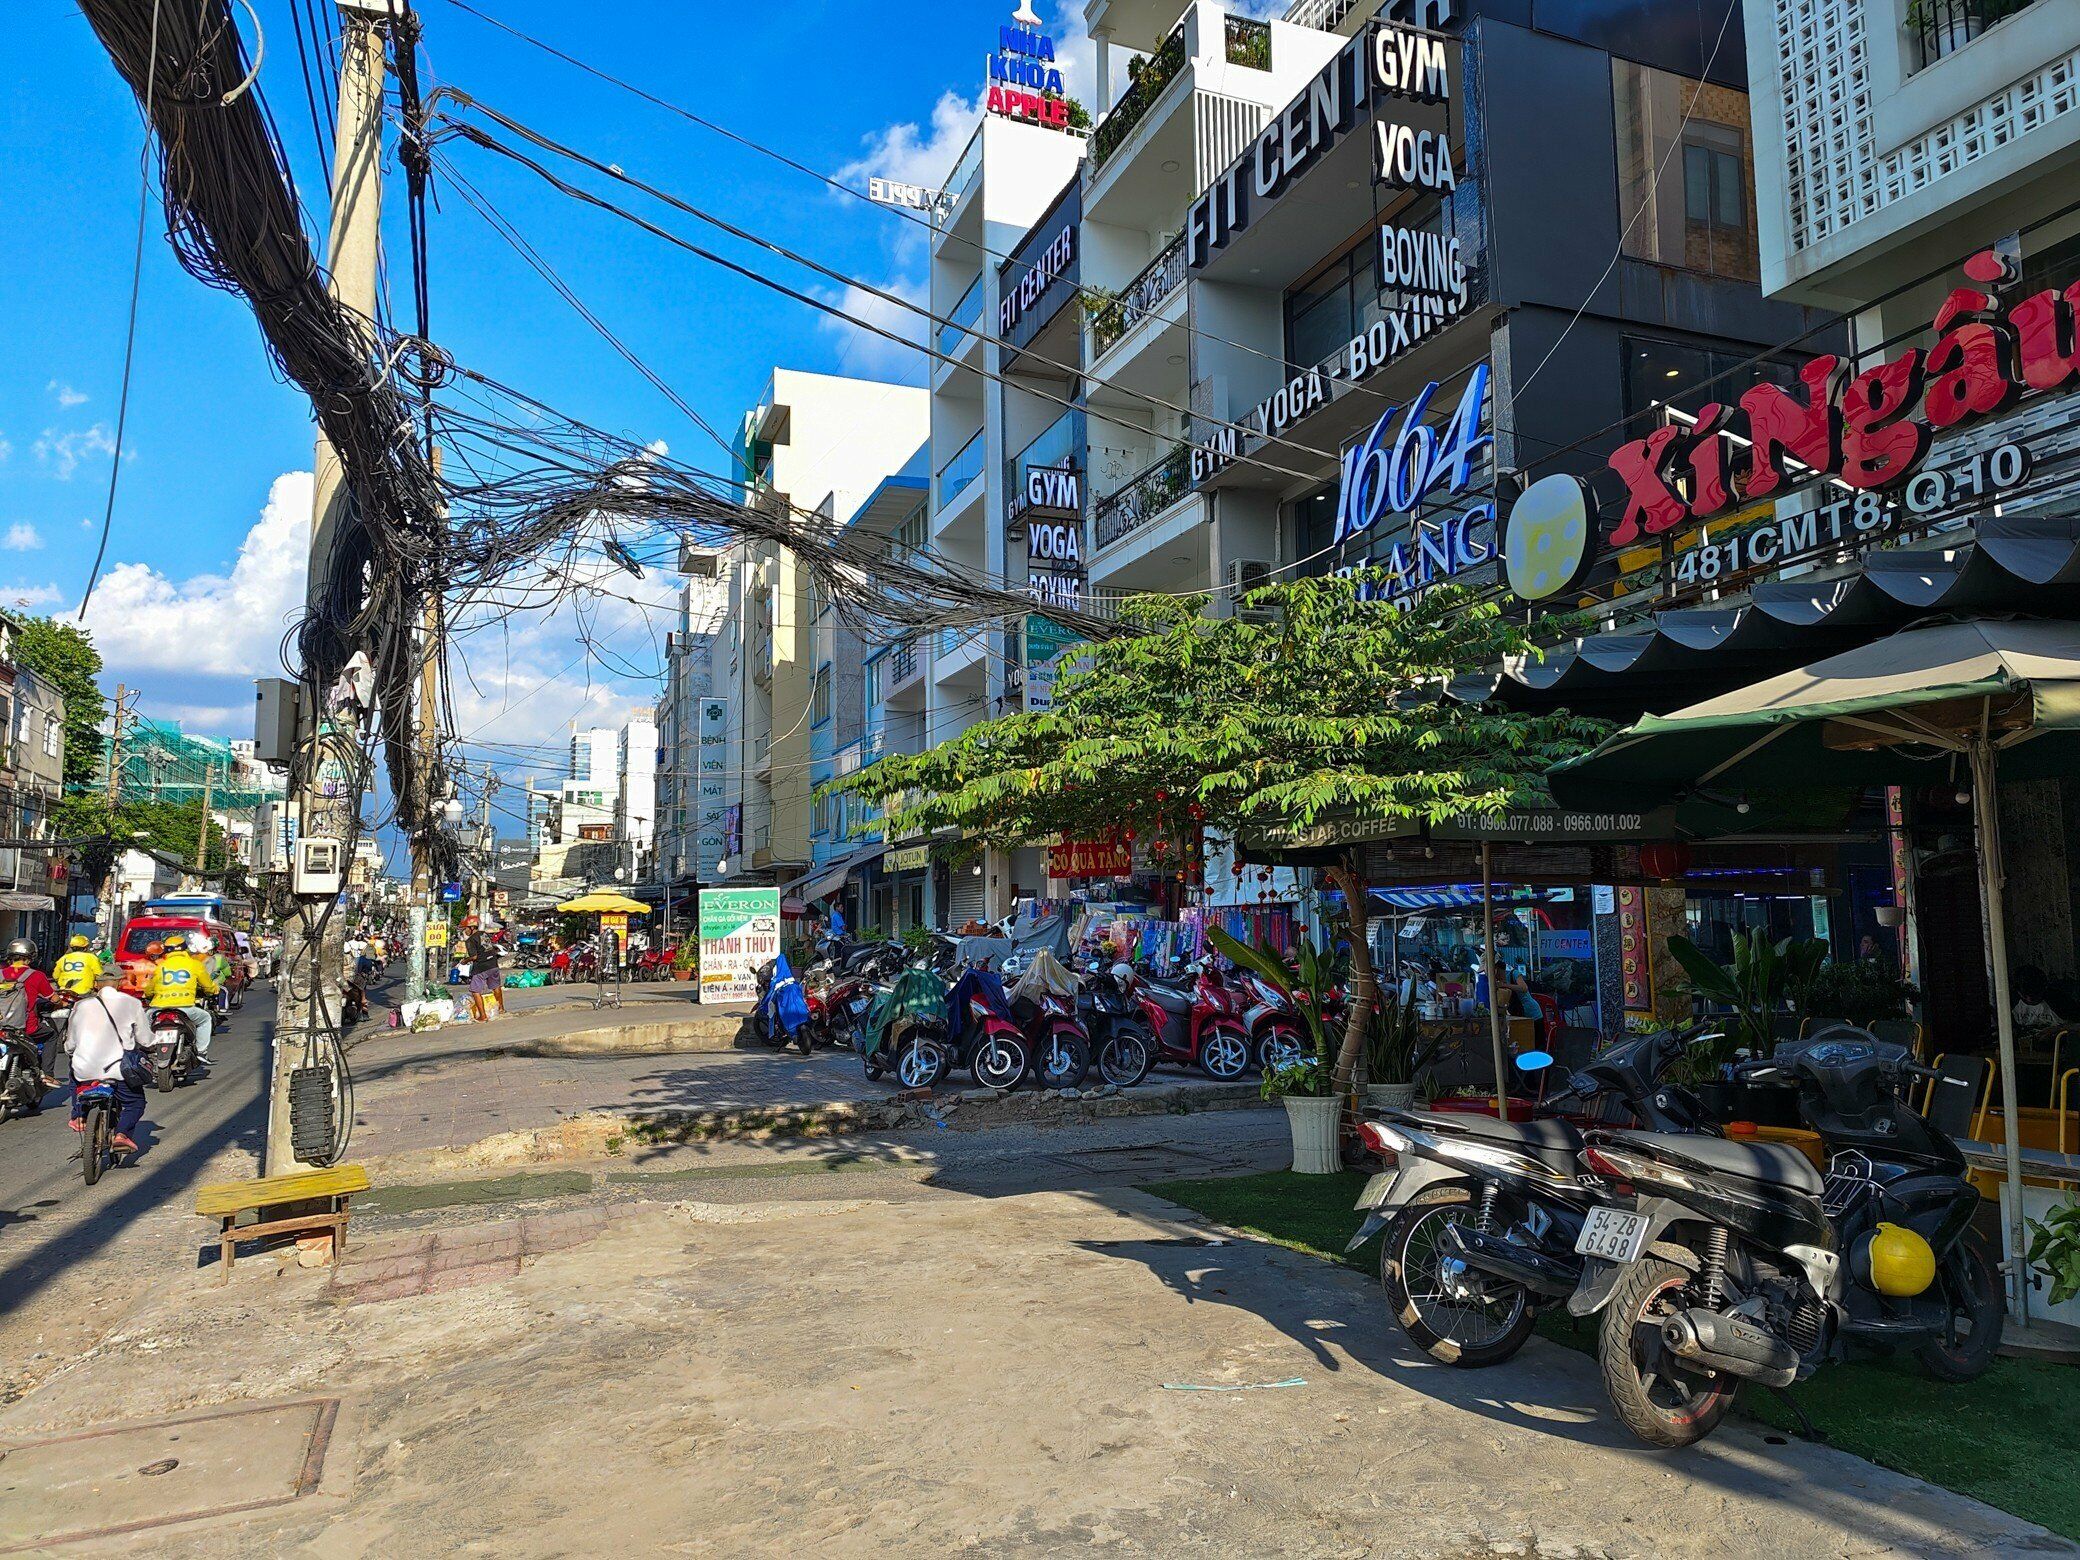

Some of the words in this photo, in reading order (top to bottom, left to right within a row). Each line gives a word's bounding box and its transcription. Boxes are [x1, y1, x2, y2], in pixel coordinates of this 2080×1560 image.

[1000, 25, 1054, 62] NHA
[990, 55, 1064, 94] KHOA
[1375, 28, 1449, 98] GYM
[987, 86, 1069, 127] APPLE
[1376, 120, 1456, 191] YOGA
[1188, 157, 1244, 267] FIT
[1381, 225, 1461, 294] BOXING
[1000, 286, 1019, 336] FIT
[1021, 224, 1071, 311] CENTER
[1191, 423, 1237, 481] GYM
[1257, 365, 1323, 435] YOGA
[1333, 363, 1494, 548] 1664
[1028, 471, 1078, 510] GYM
[1906, 445, 2022, 513] Q.10
[1029, 523, 1079, 561] YOGA
[1029, 574, 1080, 612] BOXING
[1031, 624, 1077, 636] EVERO
[701, 734, 726, 747] BỆNH
[702, 759, 723, 770] VIỆN
[1300, 823, 1336, 842] STAR
[1340, 816, 1397, 839] COFFEE
[1564, 814, 1641, 831] 0966.001.002
[1053, 848, 1069, 871] CÓ
[1071, 847, 1096, 873] QUÀ
[703, 899, 775, 911] EVERON
[703, 937, 741, 955] THANH
[63, 958, 85, 973] be
[161, 966, 191, 985] be
[1585, 1231, 1630, 1259] 6498
